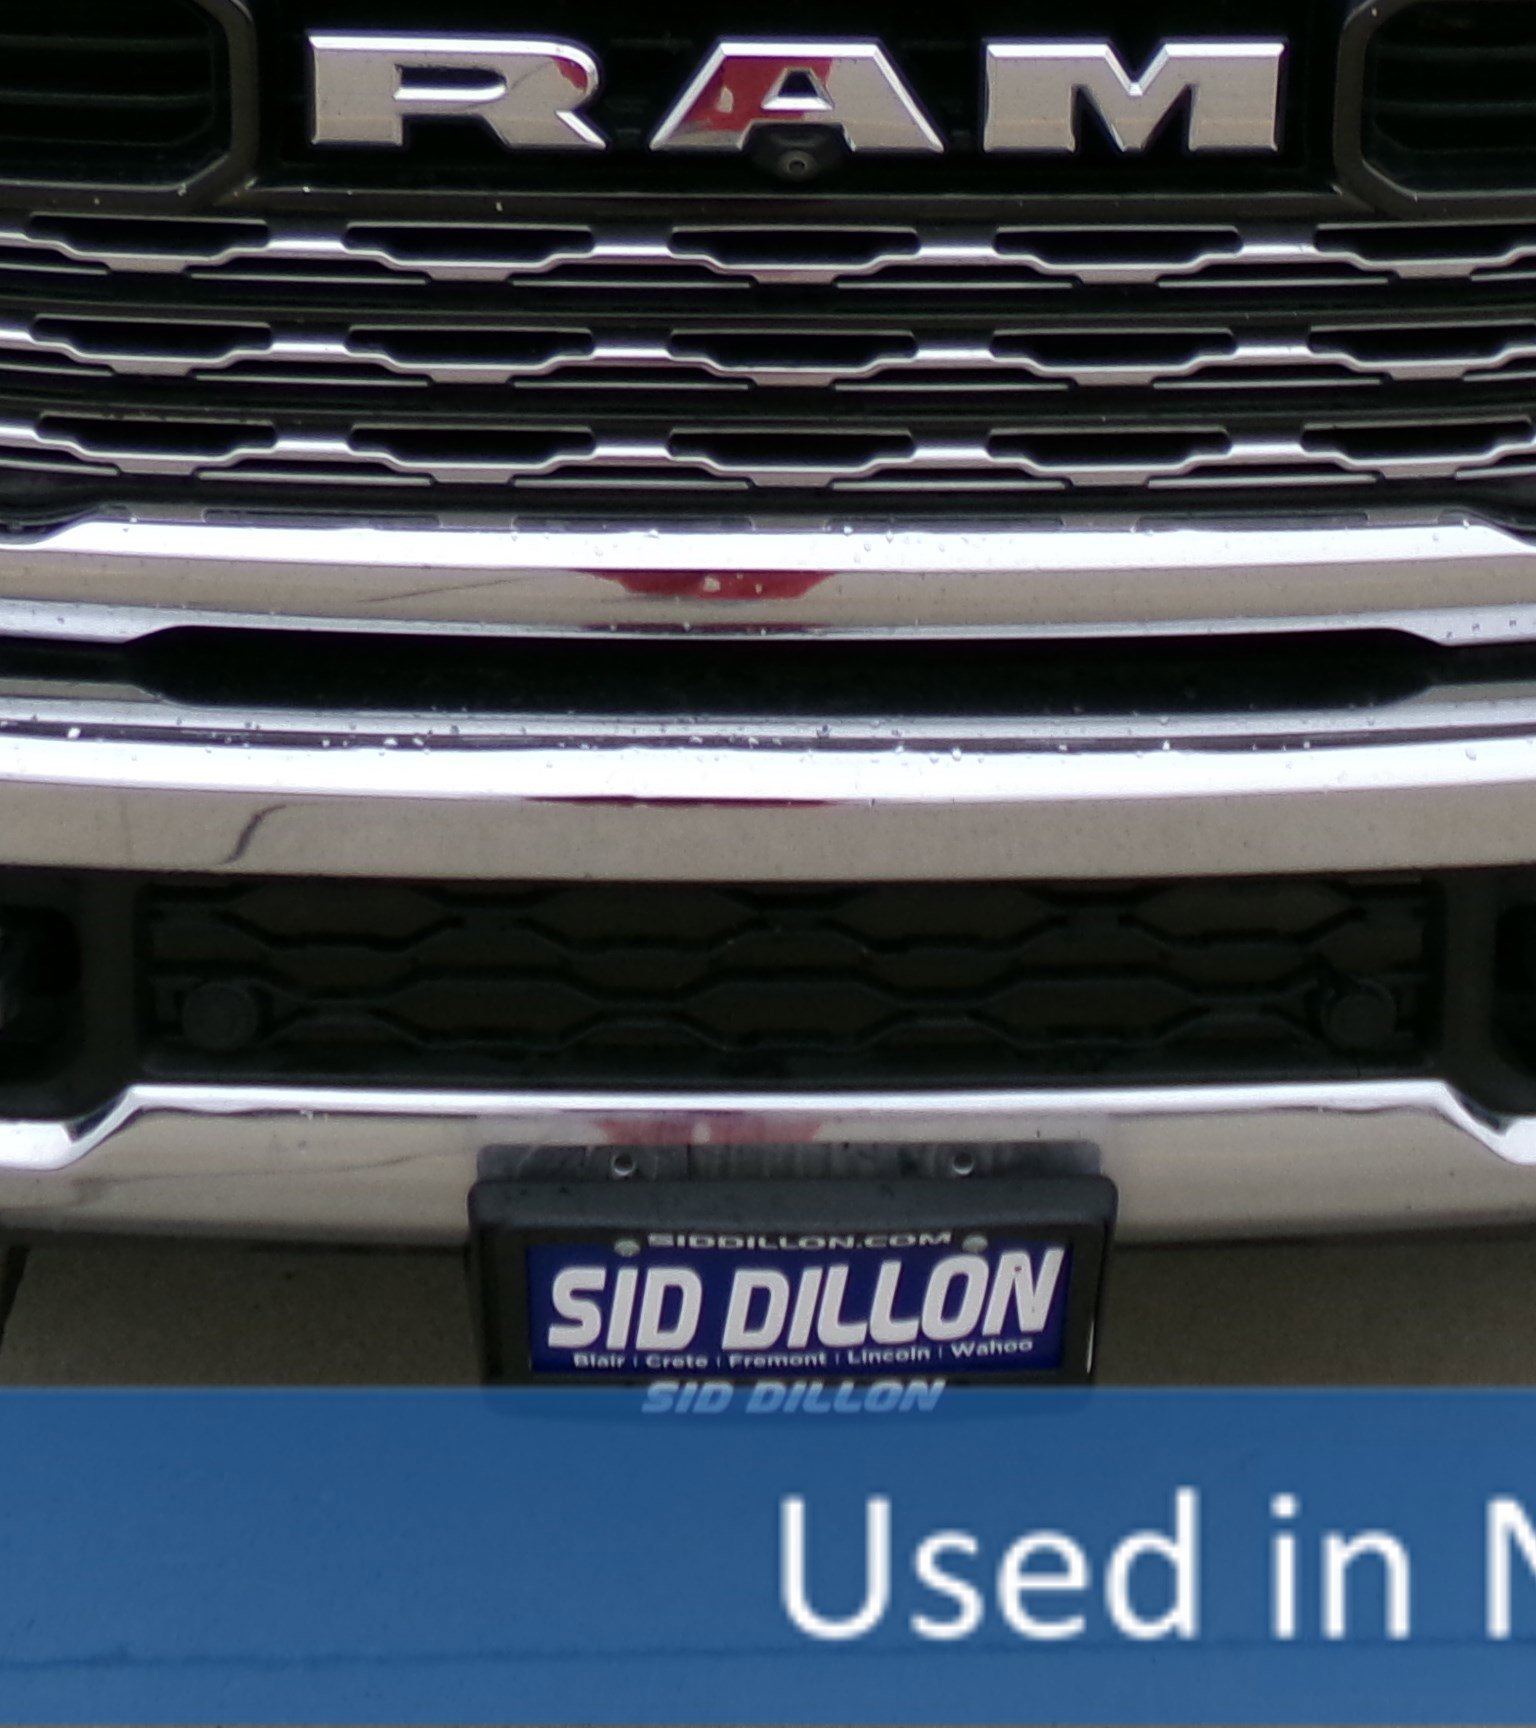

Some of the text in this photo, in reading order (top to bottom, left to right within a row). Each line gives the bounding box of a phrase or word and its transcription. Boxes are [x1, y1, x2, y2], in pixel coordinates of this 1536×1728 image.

[307, 31, 1285, 152] RAM
[647, 1232, 952, 1251] SIDDILLON.COM
[547, 1247, 1064, 1351] SID DILLON
[572, 1338, 1034, 1370] Blair Crete Fremont Lincoln Wahoo
[641, 1377, 946, 1415] SID DILLON
